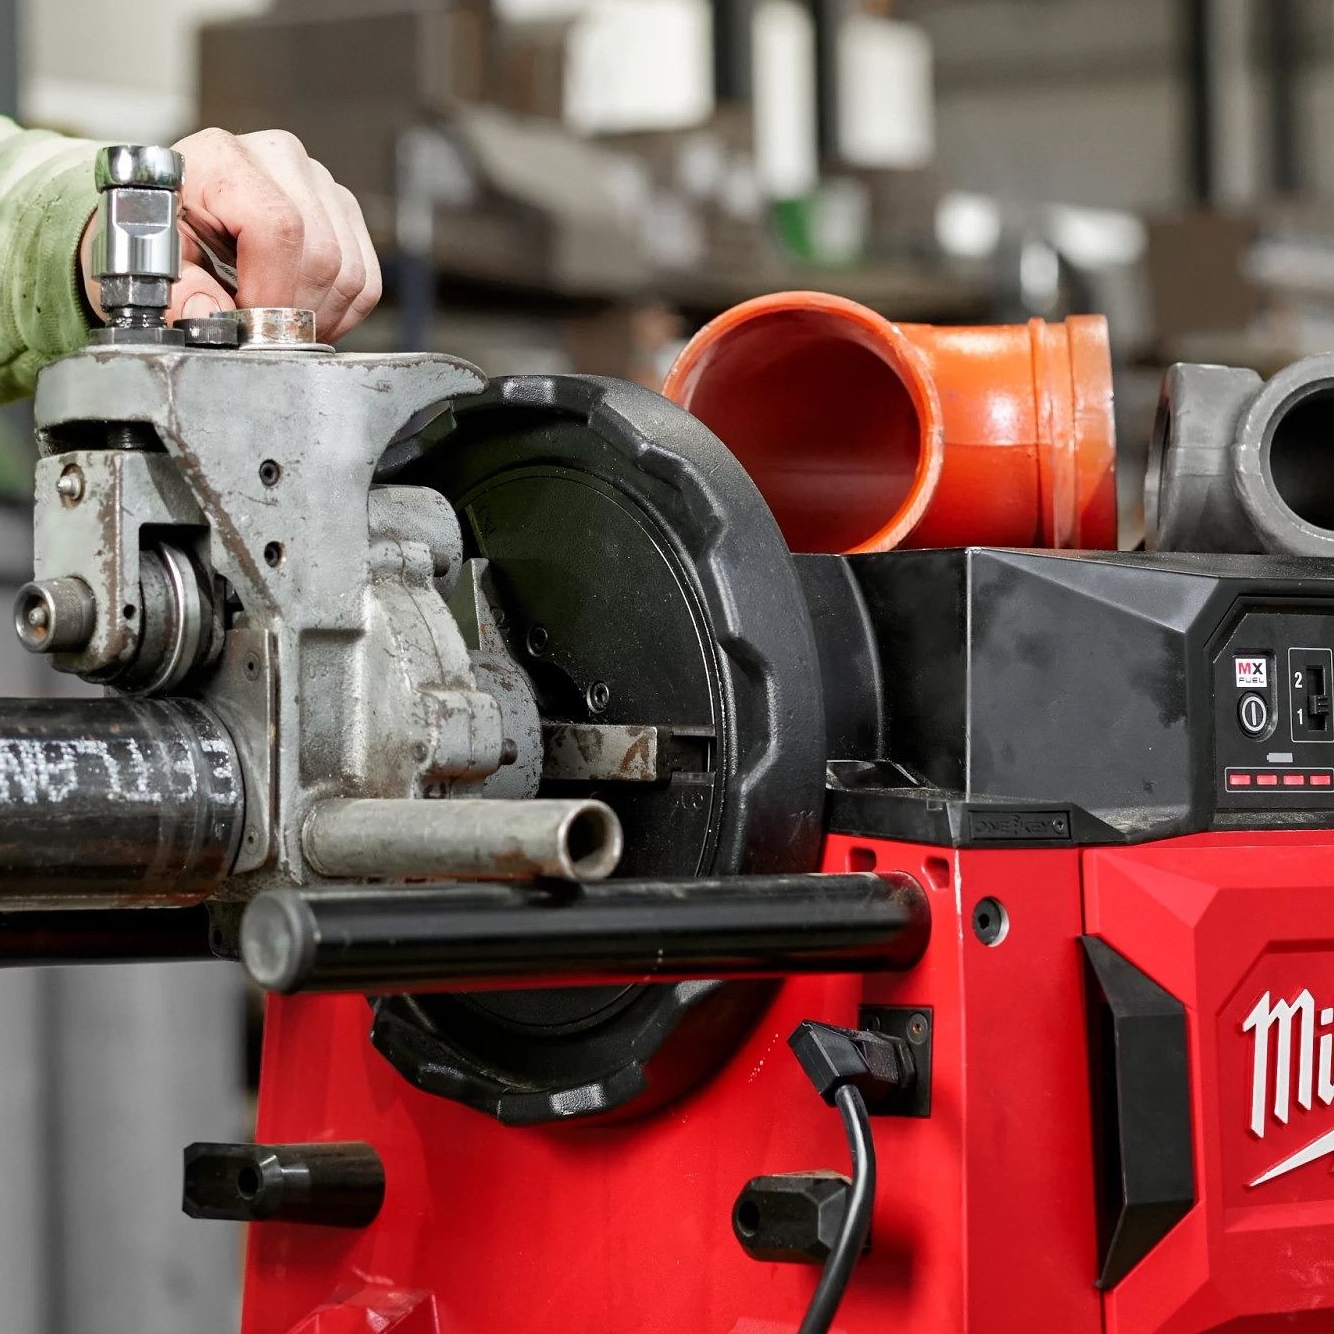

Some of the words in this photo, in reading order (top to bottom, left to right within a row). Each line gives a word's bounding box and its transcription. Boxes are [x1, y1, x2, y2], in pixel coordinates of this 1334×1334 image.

[1238, 662, 1263, 675] MX
[1294, 671, 1303, 688] 2
[1296, 708, 1303, 725] 1
